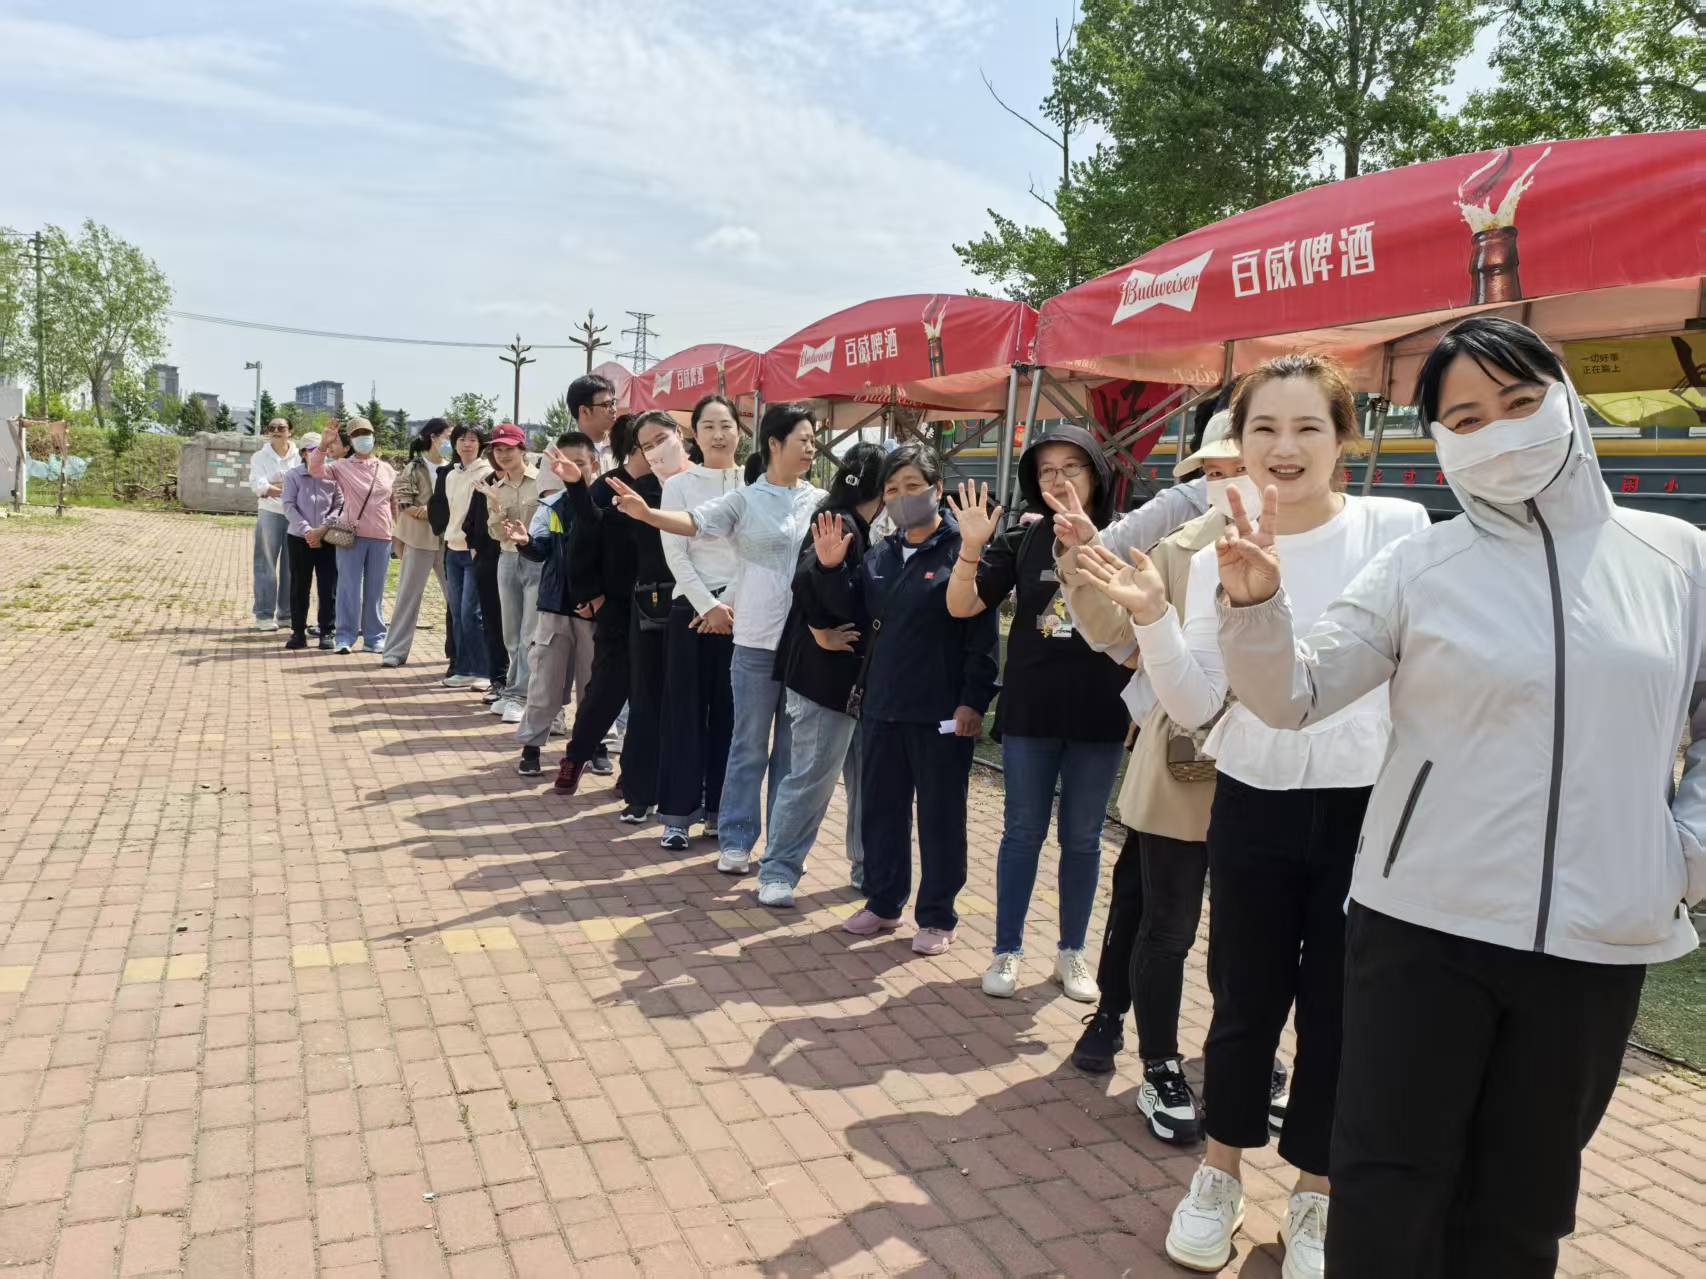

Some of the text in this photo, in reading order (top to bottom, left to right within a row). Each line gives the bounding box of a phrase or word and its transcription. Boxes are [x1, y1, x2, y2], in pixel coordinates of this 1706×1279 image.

[1231, 221, 1375, 298] 百威啤酒
[1120, 272, 1200, 306] Budweiser
[844, 327, 898, 367] 百威啤酒
